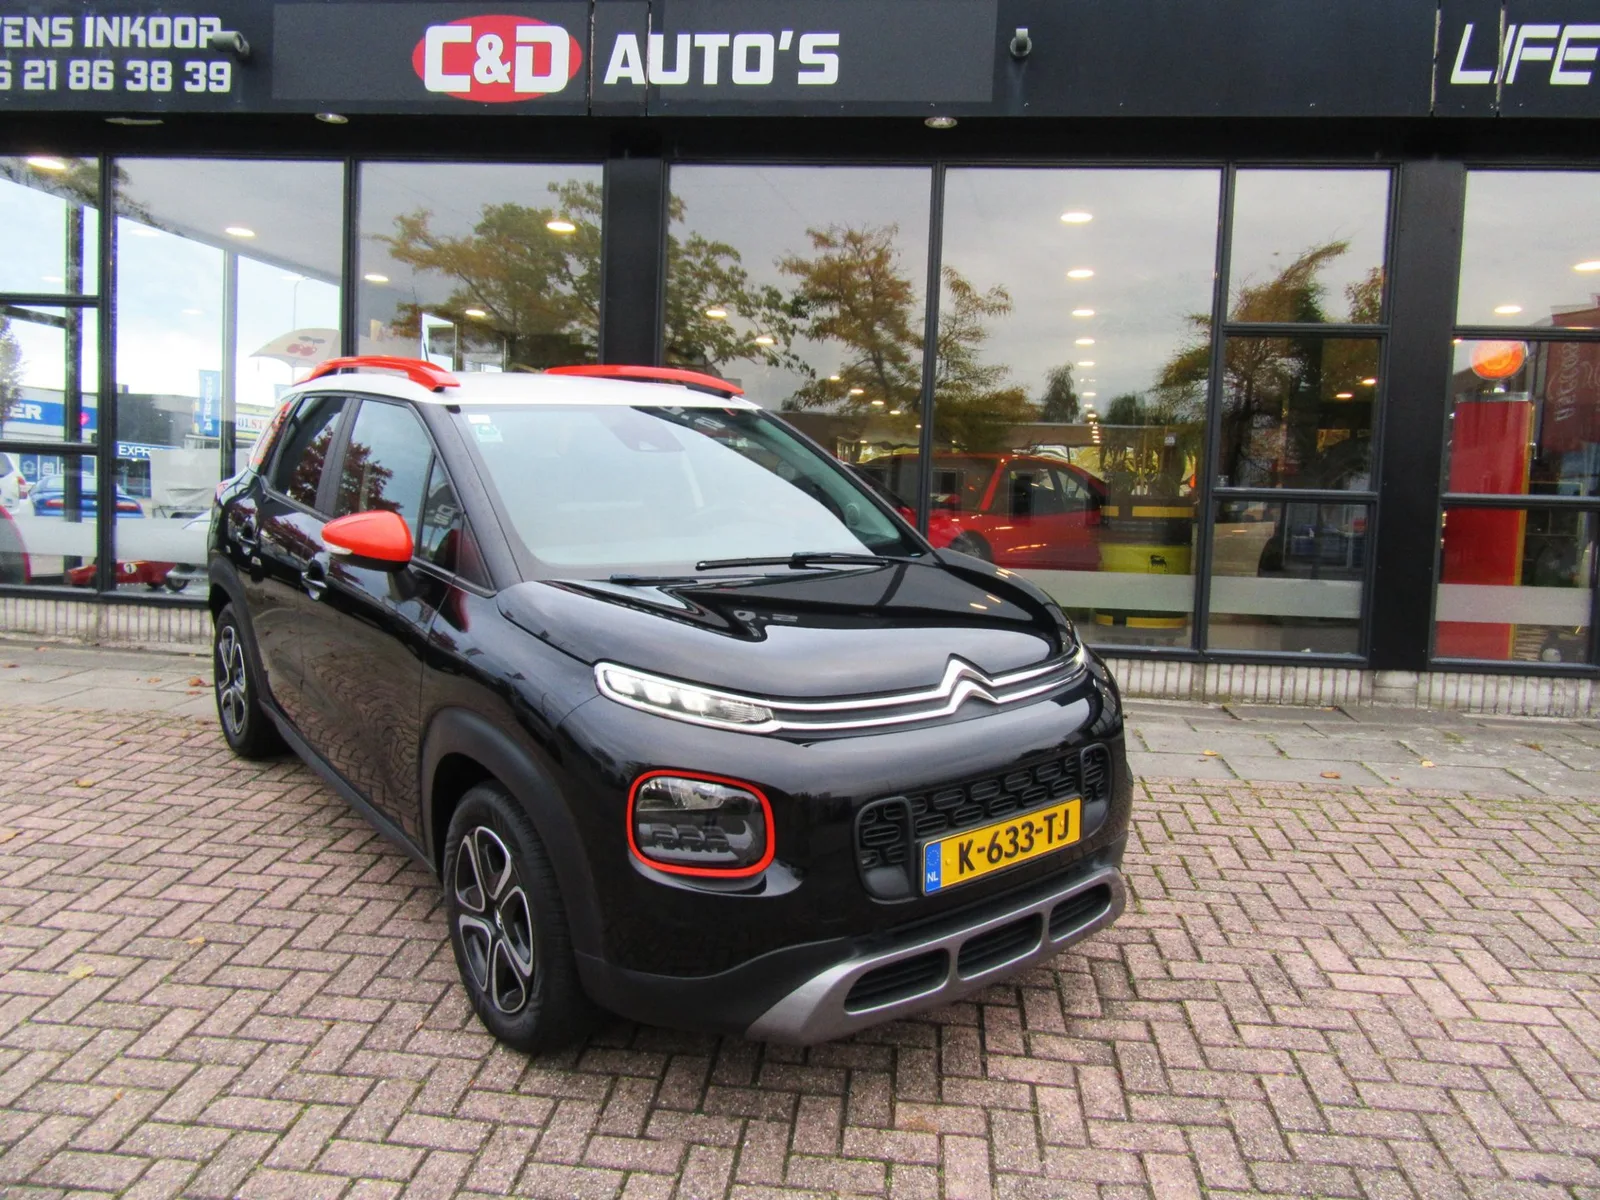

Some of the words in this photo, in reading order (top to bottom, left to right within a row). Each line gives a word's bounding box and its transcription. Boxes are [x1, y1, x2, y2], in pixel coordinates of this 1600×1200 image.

[0, 17, 73, 48] ENS
[85, 17, 222, 48] INKOOP
[1450, 24, 1600, 85] LIFE
[24, 60, 57, 90] 21
[69, 60, 114, 91] 86
[126, 60, 172, 92] 38
[184, 61, 232, 93] 39
[424, 25, 570, 93] C&D
[603, 30, 840, 85] AUTO'S
[958, 808, 1070, 875] K-633-TJ
[927, 871, 939, 883] NL
